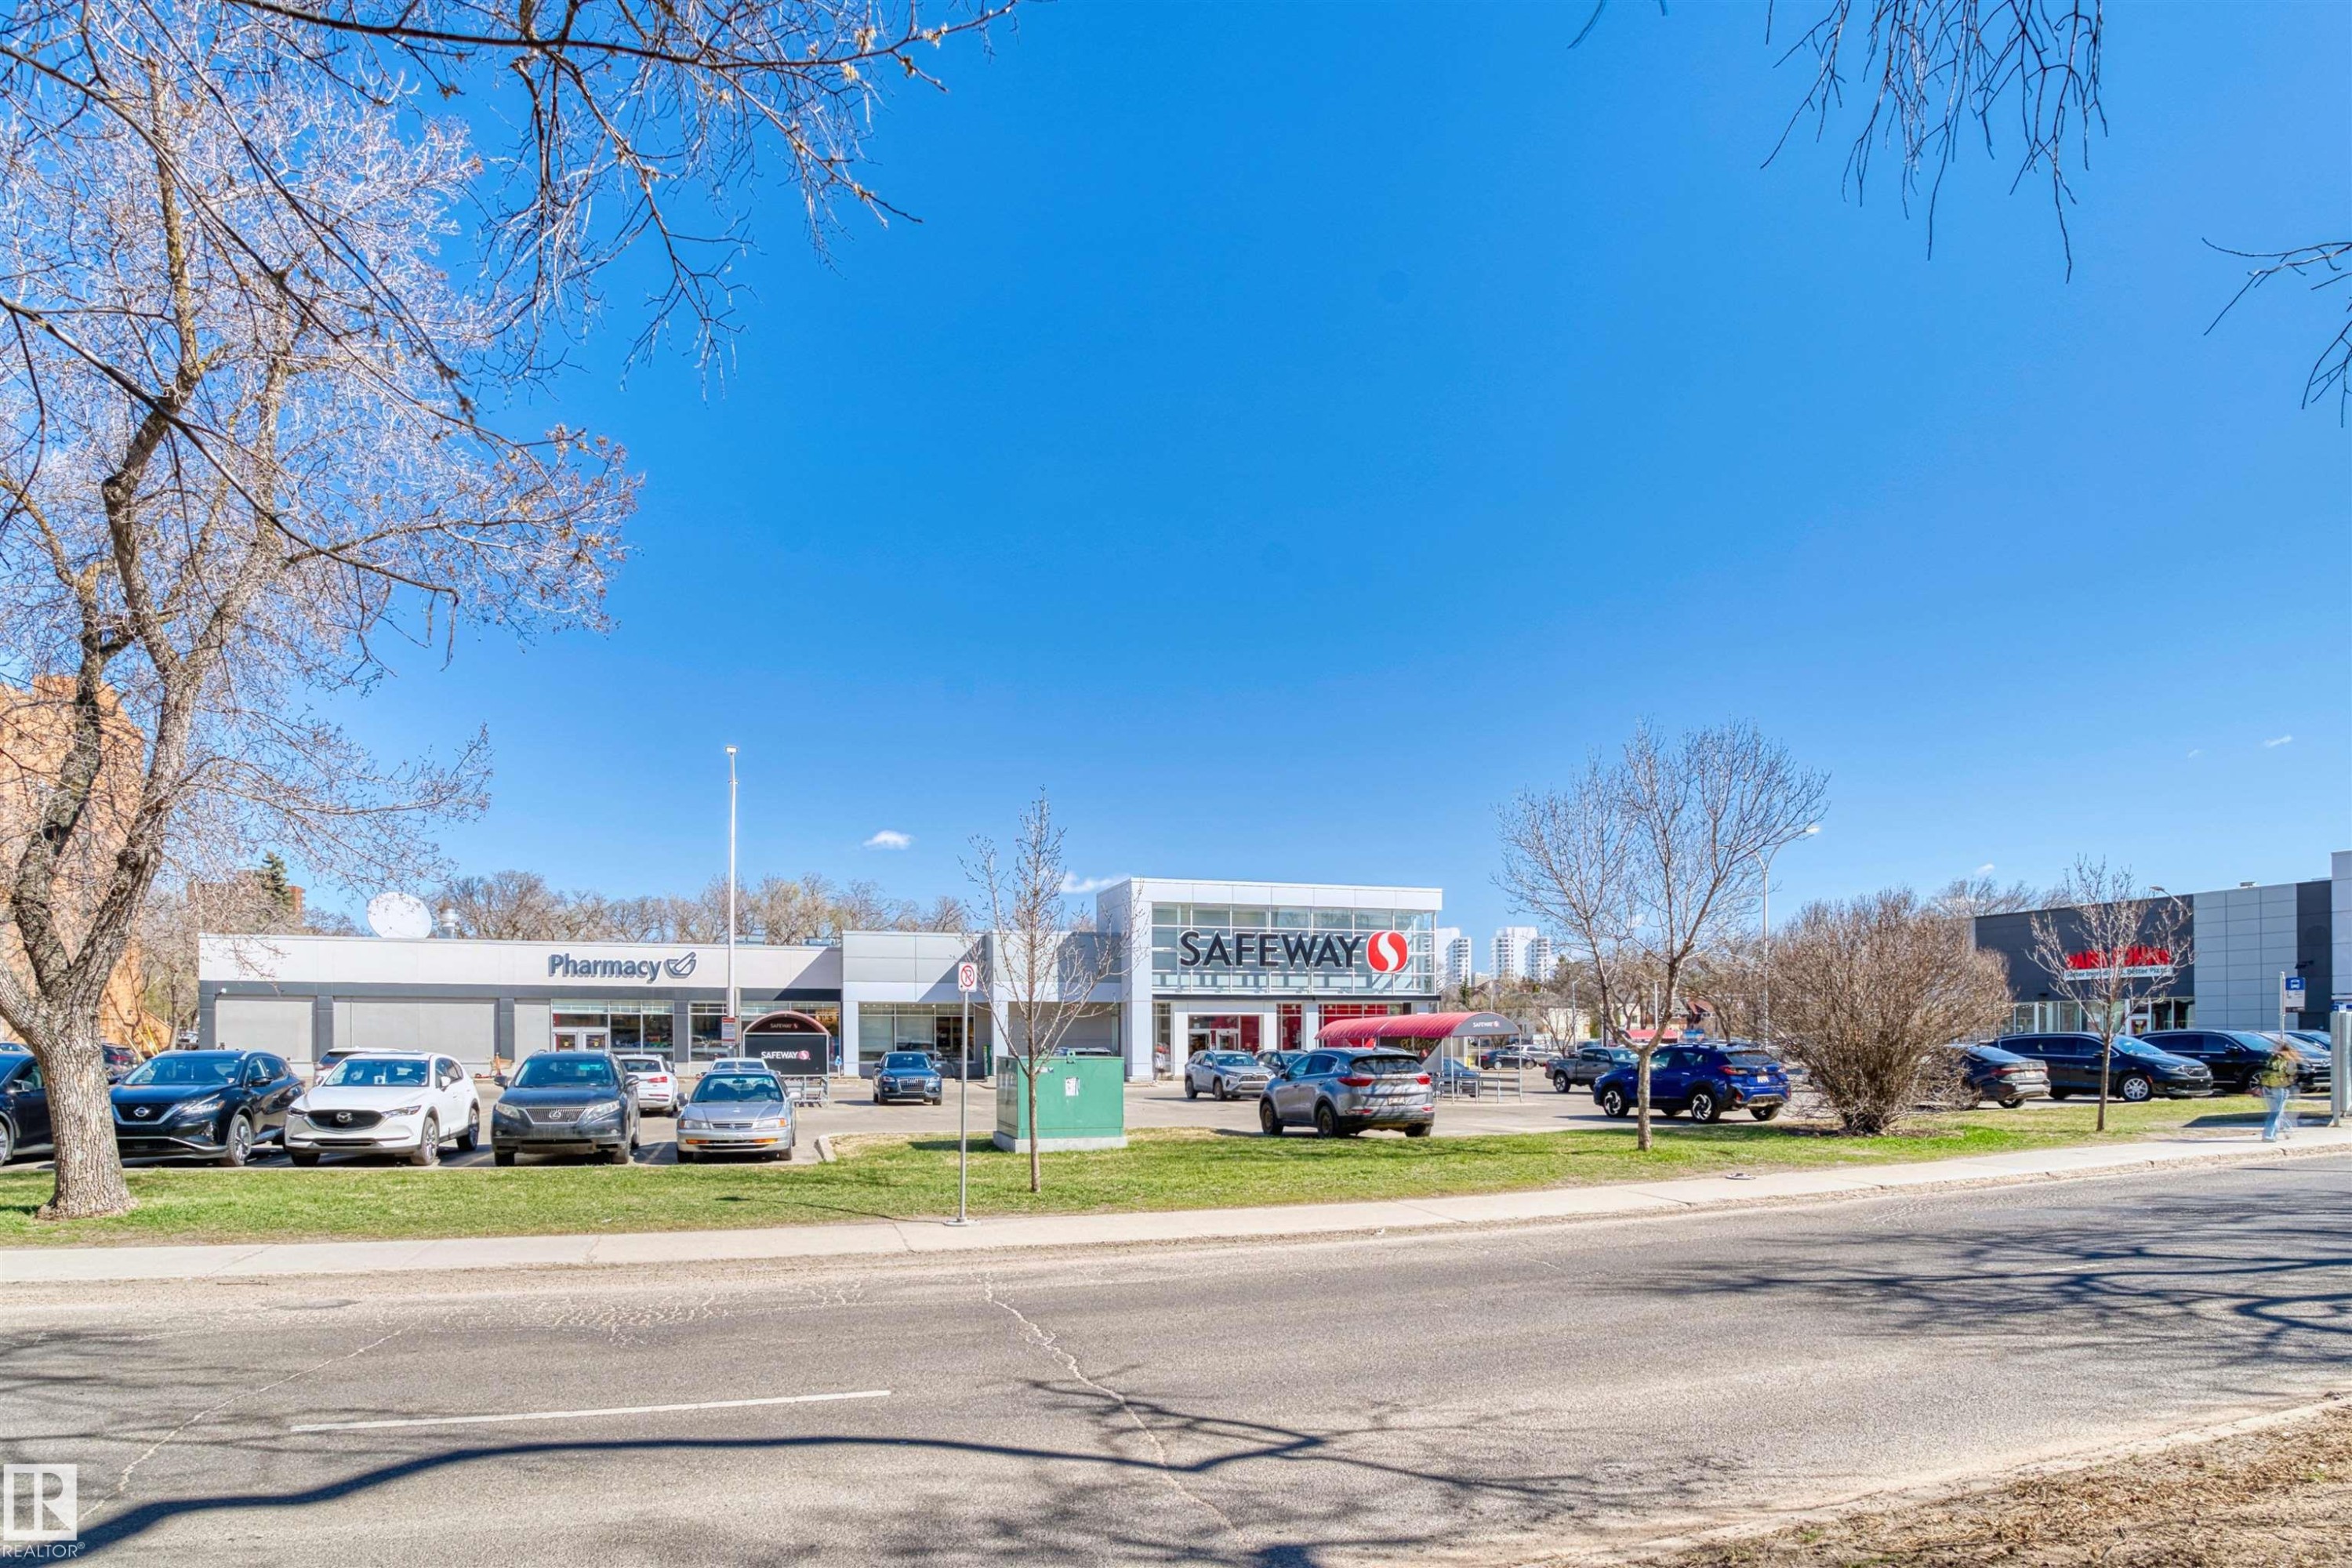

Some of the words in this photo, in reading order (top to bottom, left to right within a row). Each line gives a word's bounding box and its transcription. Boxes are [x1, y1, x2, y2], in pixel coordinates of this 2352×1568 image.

[1179, 930, 1363, 968] SAFEWAY
[548, 953, 662, 984] Pharmacy
[761, 1051, 798, 1059] SAFEWAY
